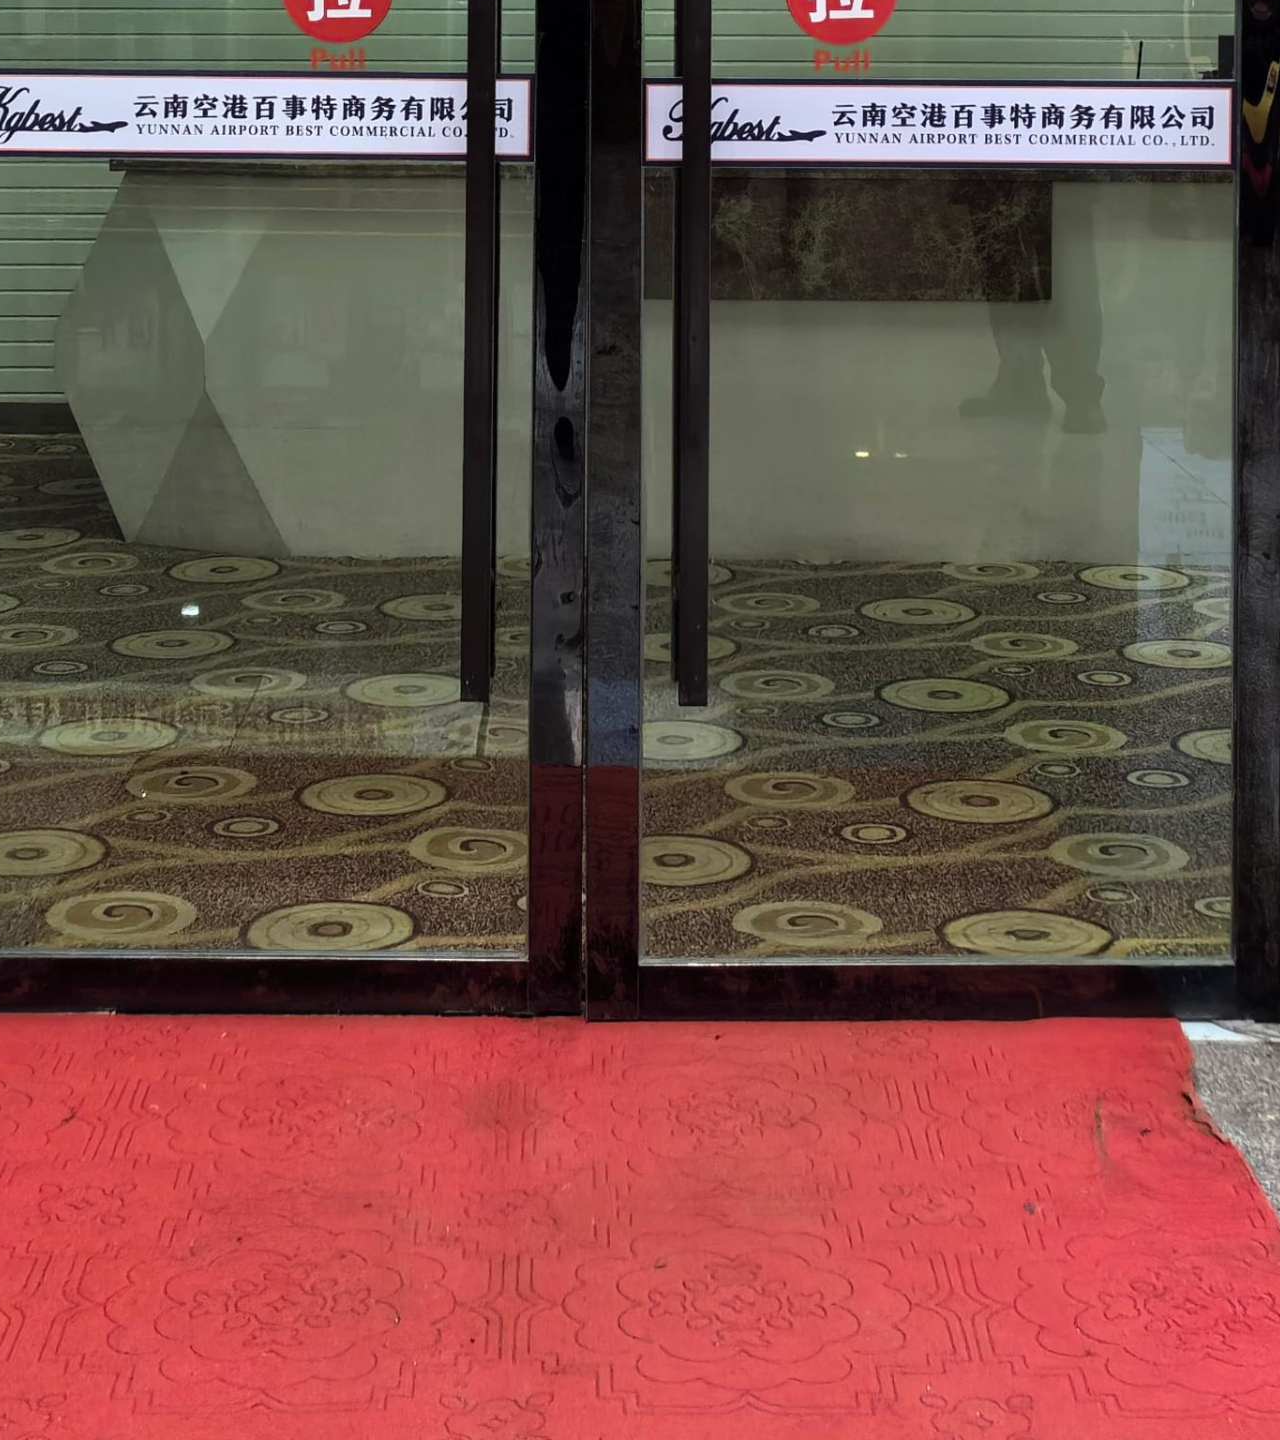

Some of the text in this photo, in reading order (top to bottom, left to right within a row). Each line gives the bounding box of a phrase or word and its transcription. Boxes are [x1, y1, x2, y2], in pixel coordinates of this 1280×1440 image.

[133, 94, 514, 123] 云南空港百事特商务有限司
[831, 103, 1216, 131] 云南空港百事特商务有限公司
[136, 124, 204, 137] YUNNAN
[211, 124, 280, 137] AIRPORT
[285, 125, 323, 137] BEST
[329, 125, 436, 138] COMMERCIAL
[834, 131, 902, 146] YUNNAN
[909, 132, 978, 146] AIRPORT
[984, 133, 1021, 147] BEST
[1028, 133, 1136, 147] COMMERCIAL
